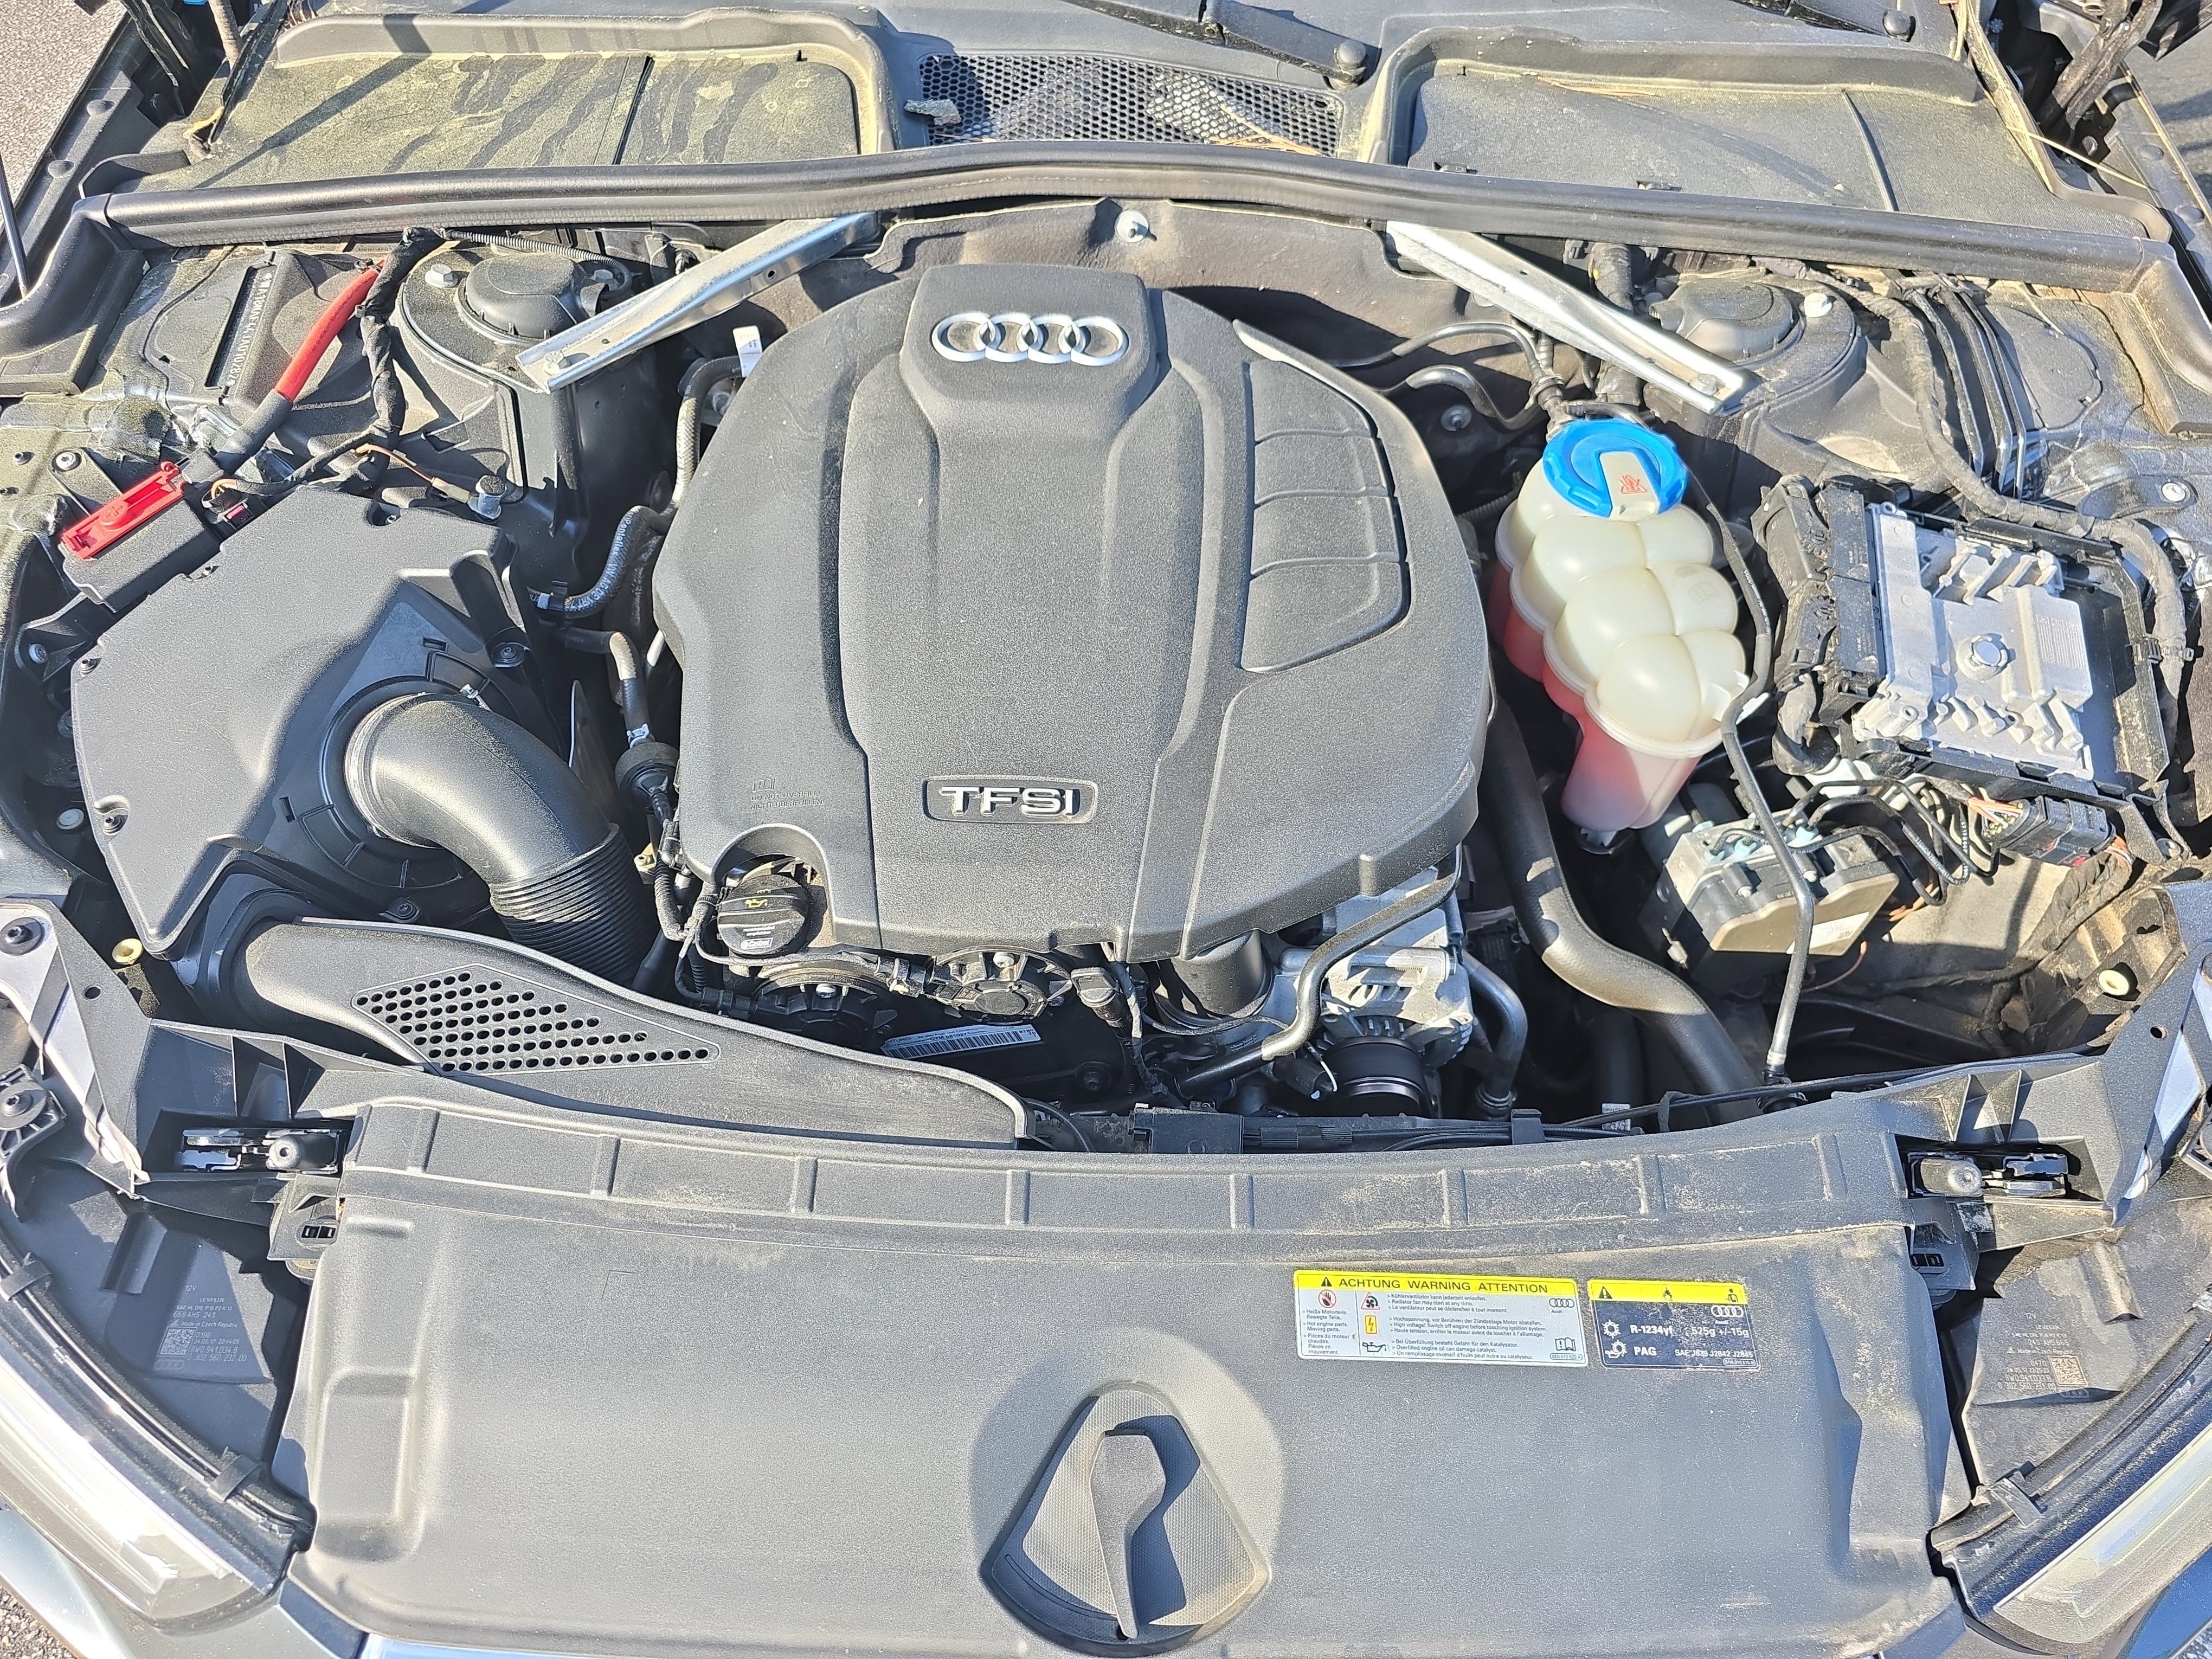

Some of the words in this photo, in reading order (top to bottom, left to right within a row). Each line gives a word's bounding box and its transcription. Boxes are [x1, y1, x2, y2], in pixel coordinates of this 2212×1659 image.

[940, 786, 1079, 816] TFSI
[1339, 1278, 1400, 1289] ACHTUNG
[1409, 1281, 1470, 1291] WARNING
[1478, 1283, 1548, 1293] ATTENTION
[1630, 1324, 1673, 1336] R-1234yf
[1691, 1326, 1716, 1338] 525g
[1634, 1347, 1657, 1356] PAG
